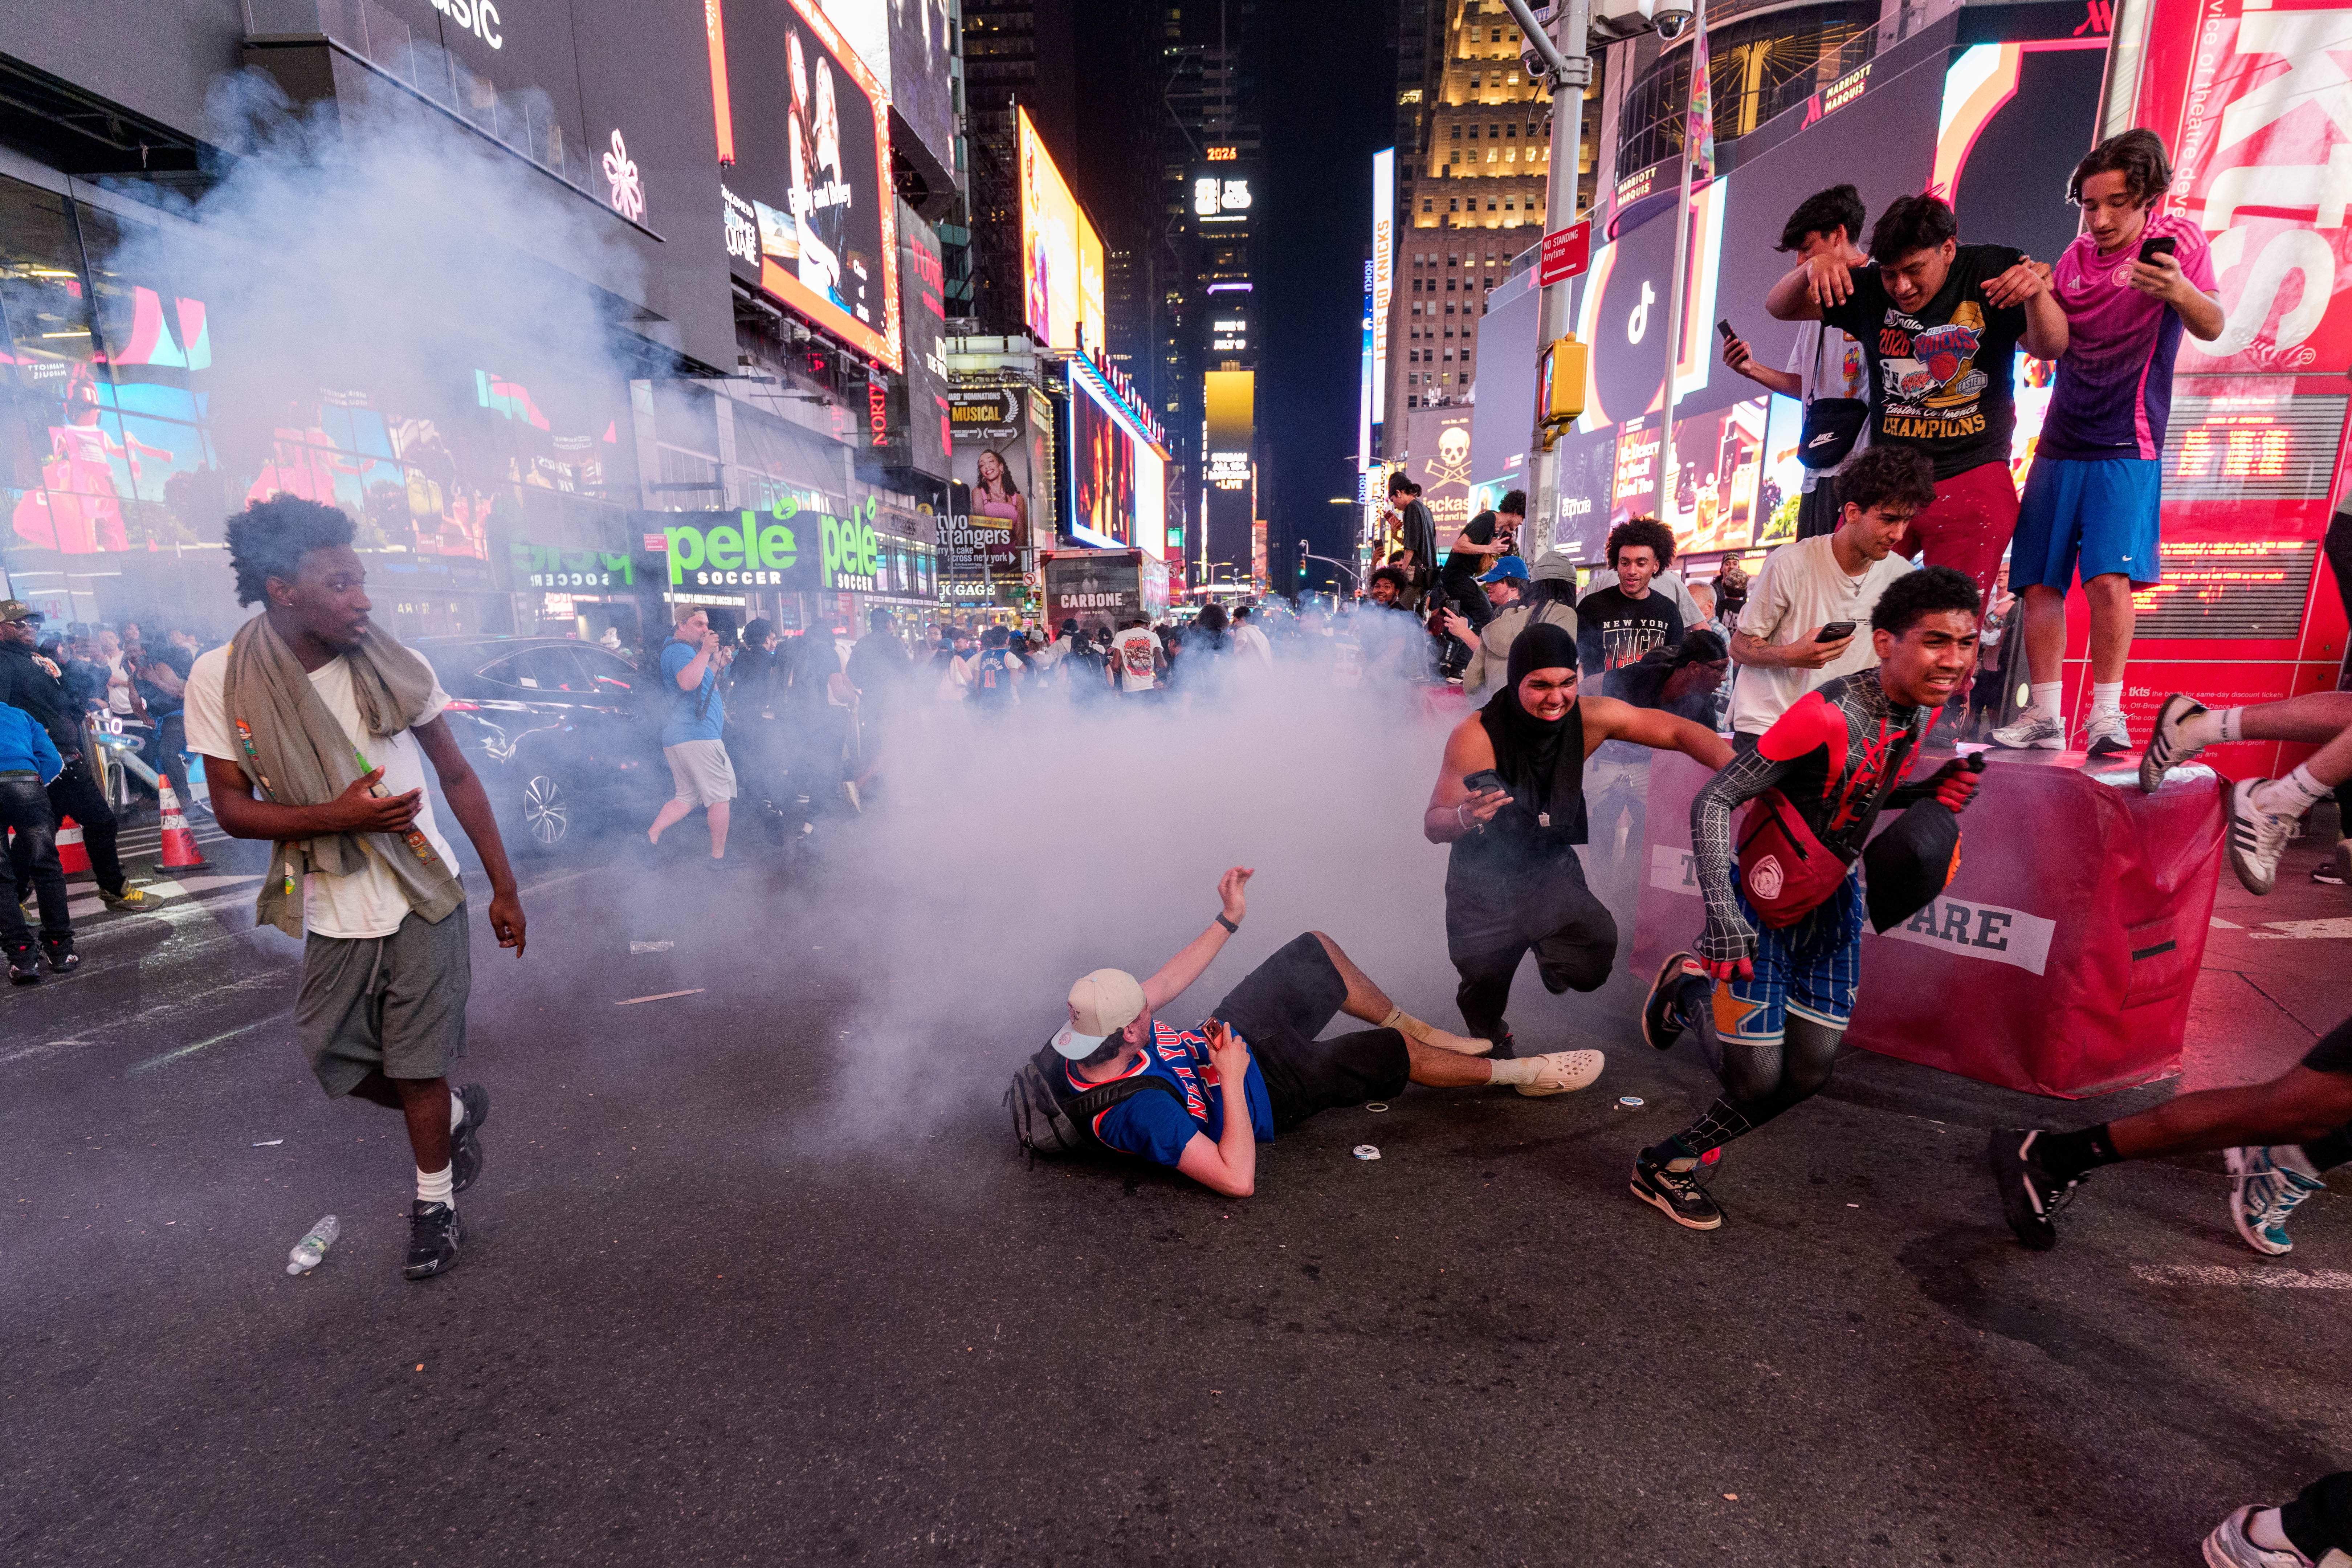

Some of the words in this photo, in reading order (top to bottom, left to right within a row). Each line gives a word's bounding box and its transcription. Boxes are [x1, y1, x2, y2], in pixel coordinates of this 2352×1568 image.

[2200, 53, 2215, 74] of
[1826, 64, 1872, 99] MARRIOTT
[1825, 82, 1864, 113] MARQUIS
[2184, 82, 2212, 159] theatre
[1207, 147, 1237, 160] 2026
[1618, 167, 1657, 195] MARRIOTT
[814, 182, 830, 209] and
[1617, 183, 1650, 207] MARQUIS
[726, 224, 759, 267] QUARE
[1544, 240, 1551, 251] NO
[1553, 229, 1578, 247] STANDING
[1377, 219, 1389, 282] KNICKS
[1543, 248, 1565, 262] Anytime
[1364, 260, 1373, 292] ROKU
[1377, 288, 1389, 309] GO
[1880, 328, 1910, 357] 2026
[1916, 329, 1977, 354] KNICKS
[1959, 374, 1986, 392] EASTERN
[963, 392, 1001, 400] NOMINATIONS
[952, 406, 1001, 421] MUSICAL
[1886, 403, 1921, 415] Eastern
[1883, 414, 1985, 438] CHAMPIONS
[1814, 432, 1834, 441] NIKE
[1221, 479, 1243, 489] LIVE
[937, 512, 967, 530] two
[1444, 513, 1460, 521] and
[664, 497, 798, 585] pelé
[821, 495, 877, 588] pelé
[956, 545, 974, 554] cake
[991, 552, 1007, 563] york
[1745, 549, 1767, 558] SEPHORA
[697, 571, 781, 585] SOCCER
[838, 573, 873, 591] SOCCER
[1061, 592, 1122, 608] CARBONE
[1603, 619, 1632, 629] NEW
[1125, 639, 1150, 649] KNICKS
[2129, 686, 2151, 697] tkts
[1153, 1019, 1187, 1061] YOR
[1172, 1067, 1209, 1124] NEW
